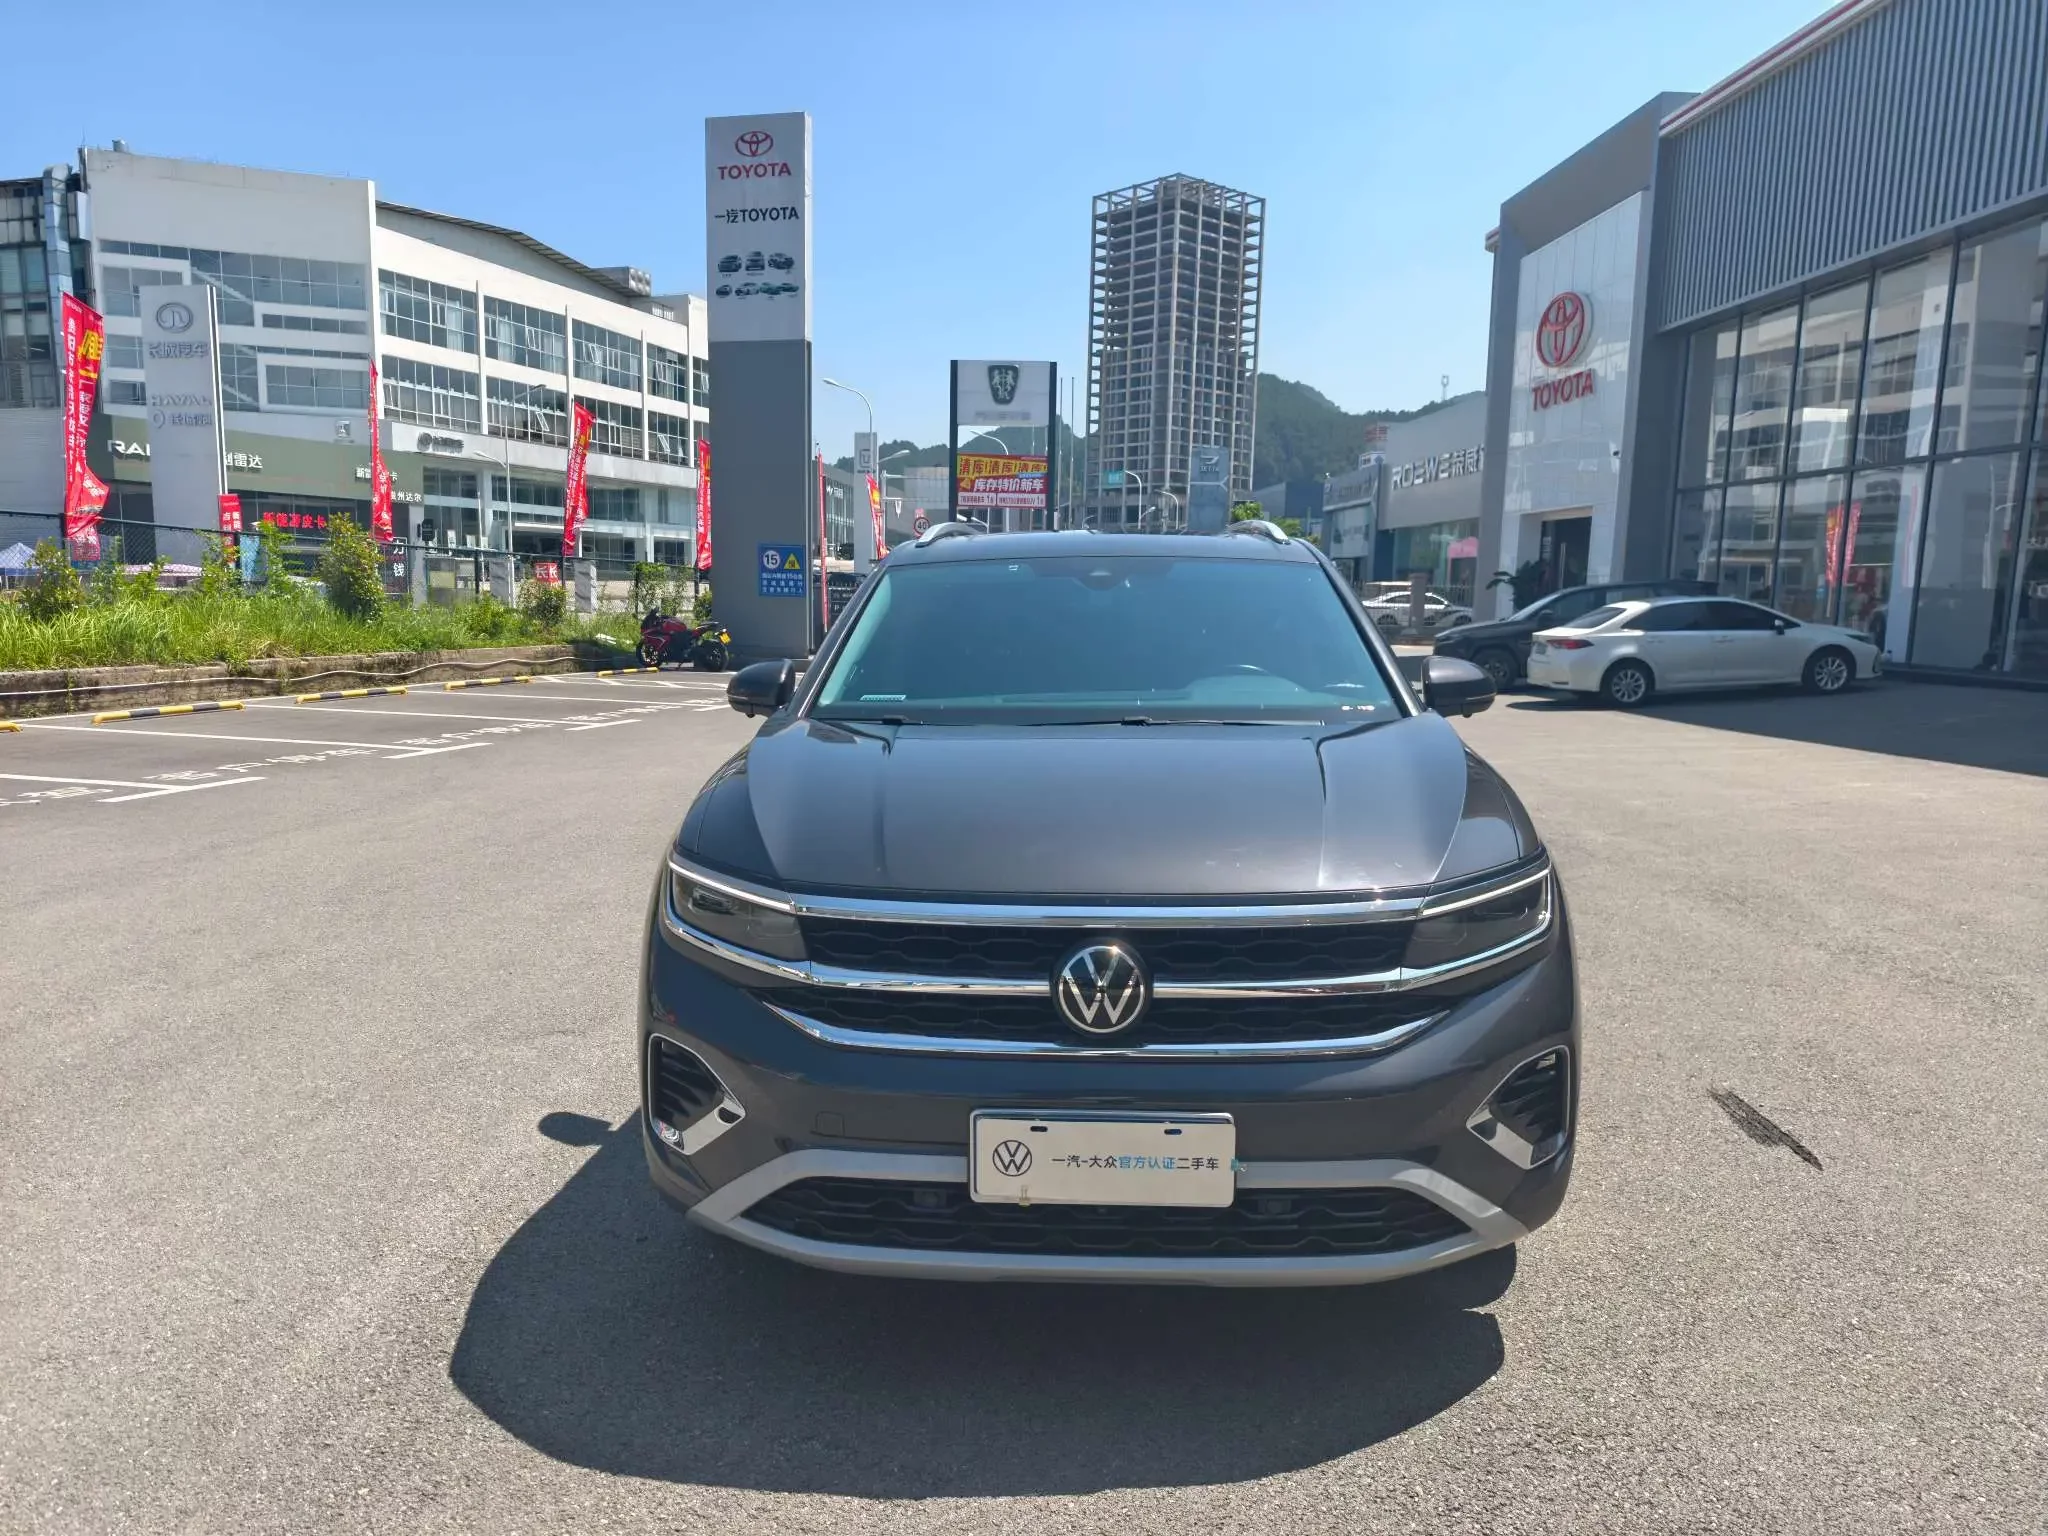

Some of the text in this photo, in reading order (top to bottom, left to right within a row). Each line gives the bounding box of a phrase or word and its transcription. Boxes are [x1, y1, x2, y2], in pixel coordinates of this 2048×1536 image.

[717, 162, 792, 180] TOYOTA
[1532, 368, 1594, 411] TOYOTA
[917, 521, 928, 531] 40
[765, 553, 778, 566] 15
[1051, 1154, 1219, 1171] 一汽-大众官方认证二手车
